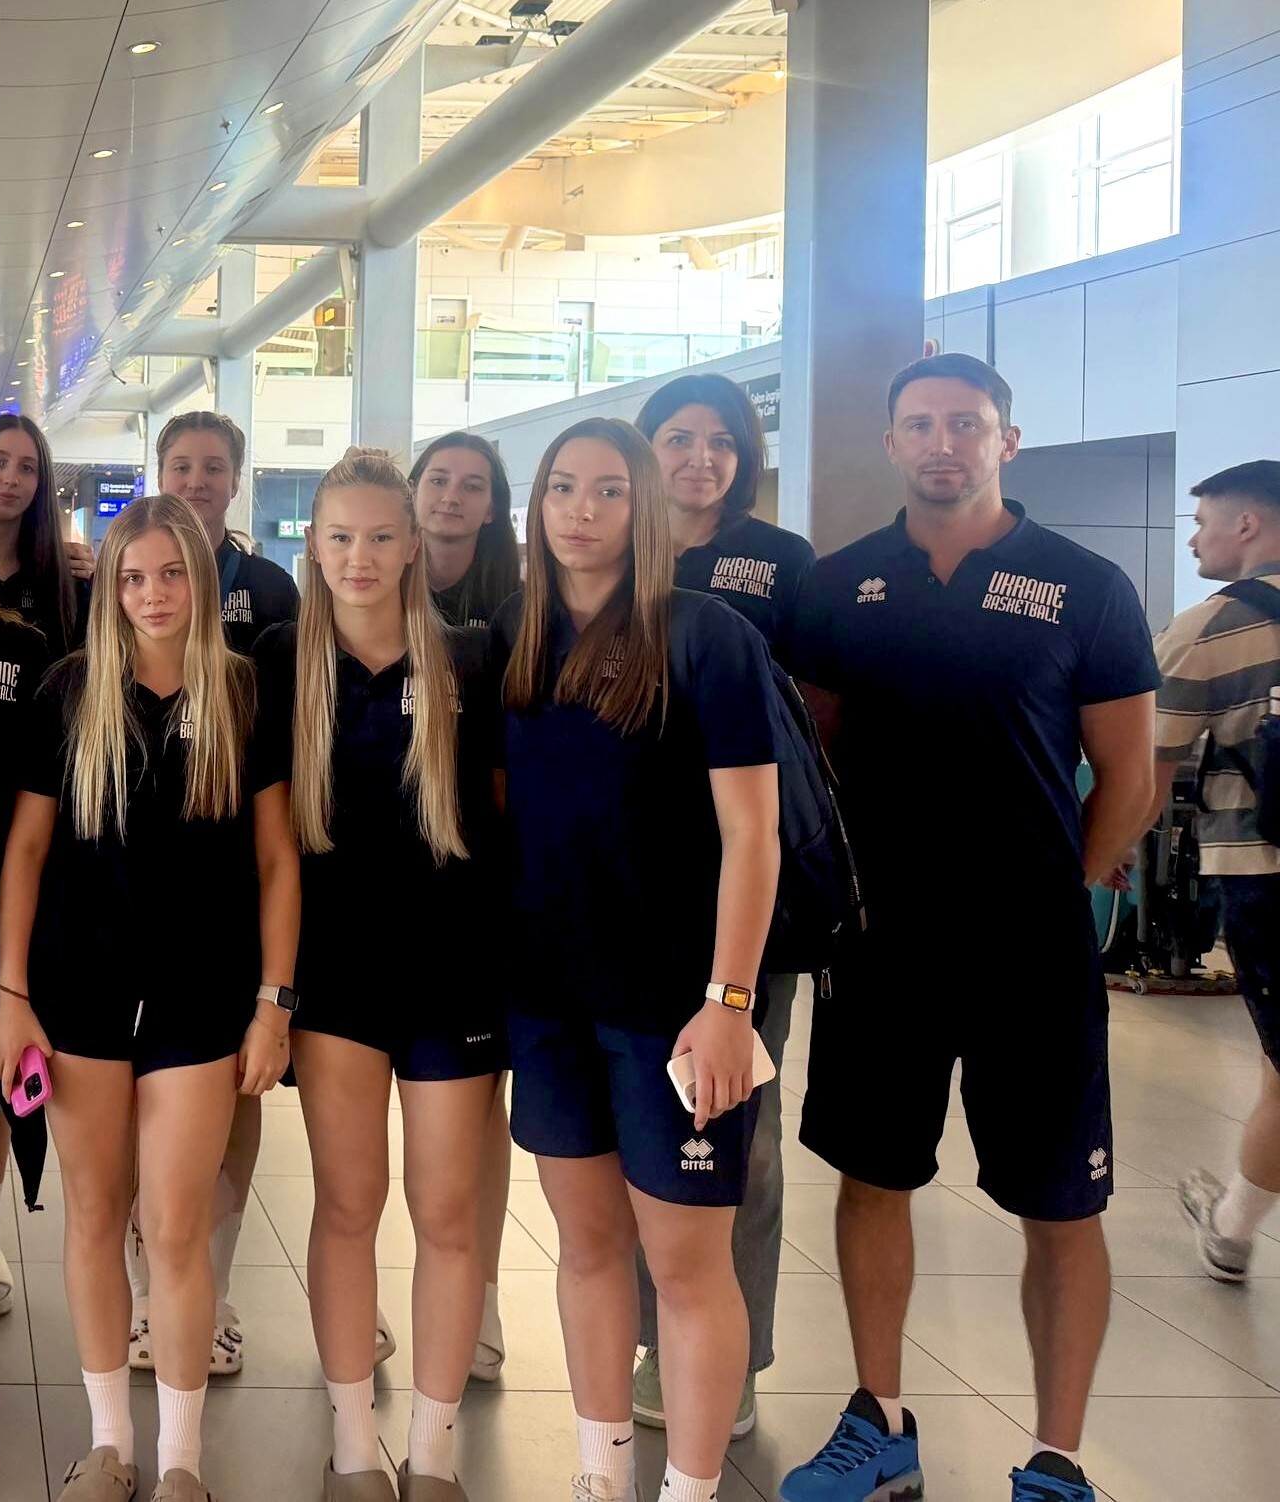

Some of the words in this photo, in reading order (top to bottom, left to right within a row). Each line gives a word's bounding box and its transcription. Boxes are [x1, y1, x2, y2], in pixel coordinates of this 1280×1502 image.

[713, 556, 777, 585] UKRAINE
[710, 575, 772, 599] BASKETBALL
[856, 592, 886, 603] errea
[988, 570, 1067, 609] UKRAINE
[981, 593, 1060, 625] BASKETBALL
[680, 1159, 714, 1171] errea
